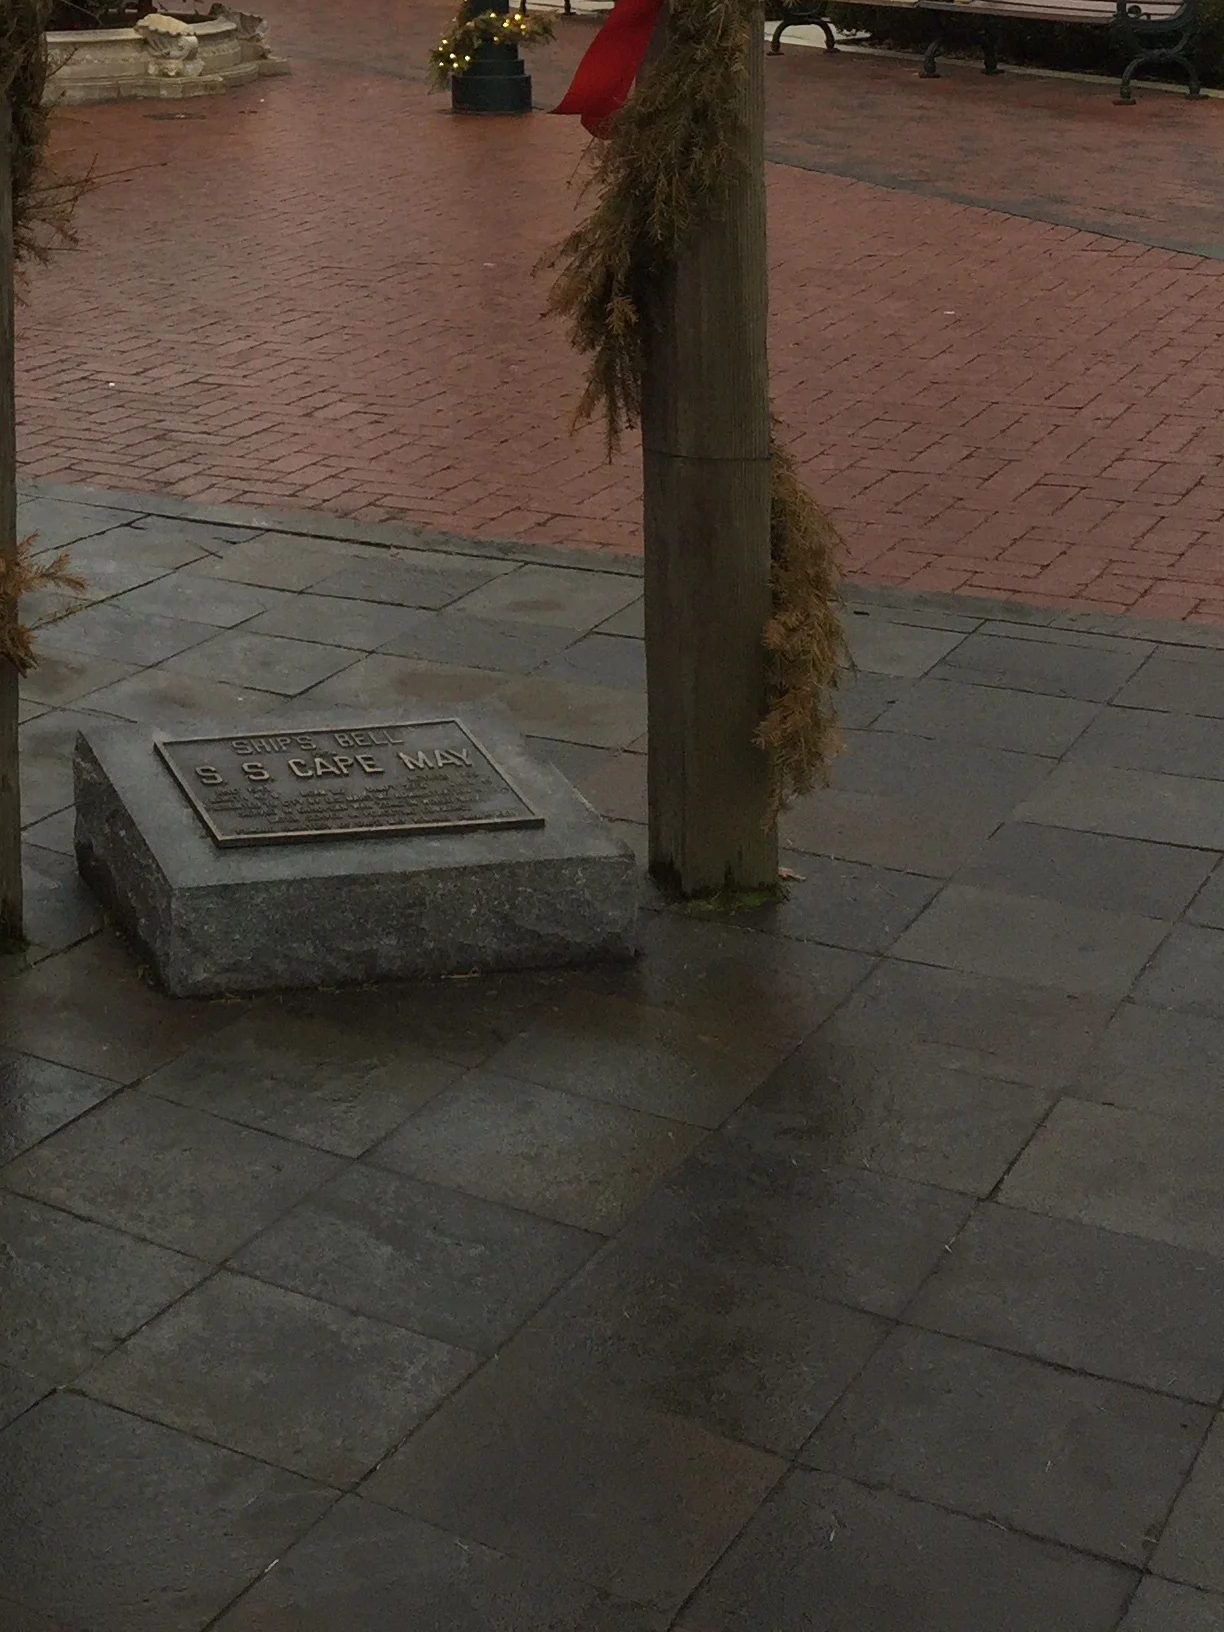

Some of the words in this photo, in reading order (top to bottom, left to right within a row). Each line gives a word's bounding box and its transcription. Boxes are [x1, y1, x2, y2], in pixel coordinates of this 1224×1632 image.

[333, 729, 405, 749] BELL
[287, 753, 385, 778] CAPE
[397, 748, 473, 771] MAY
